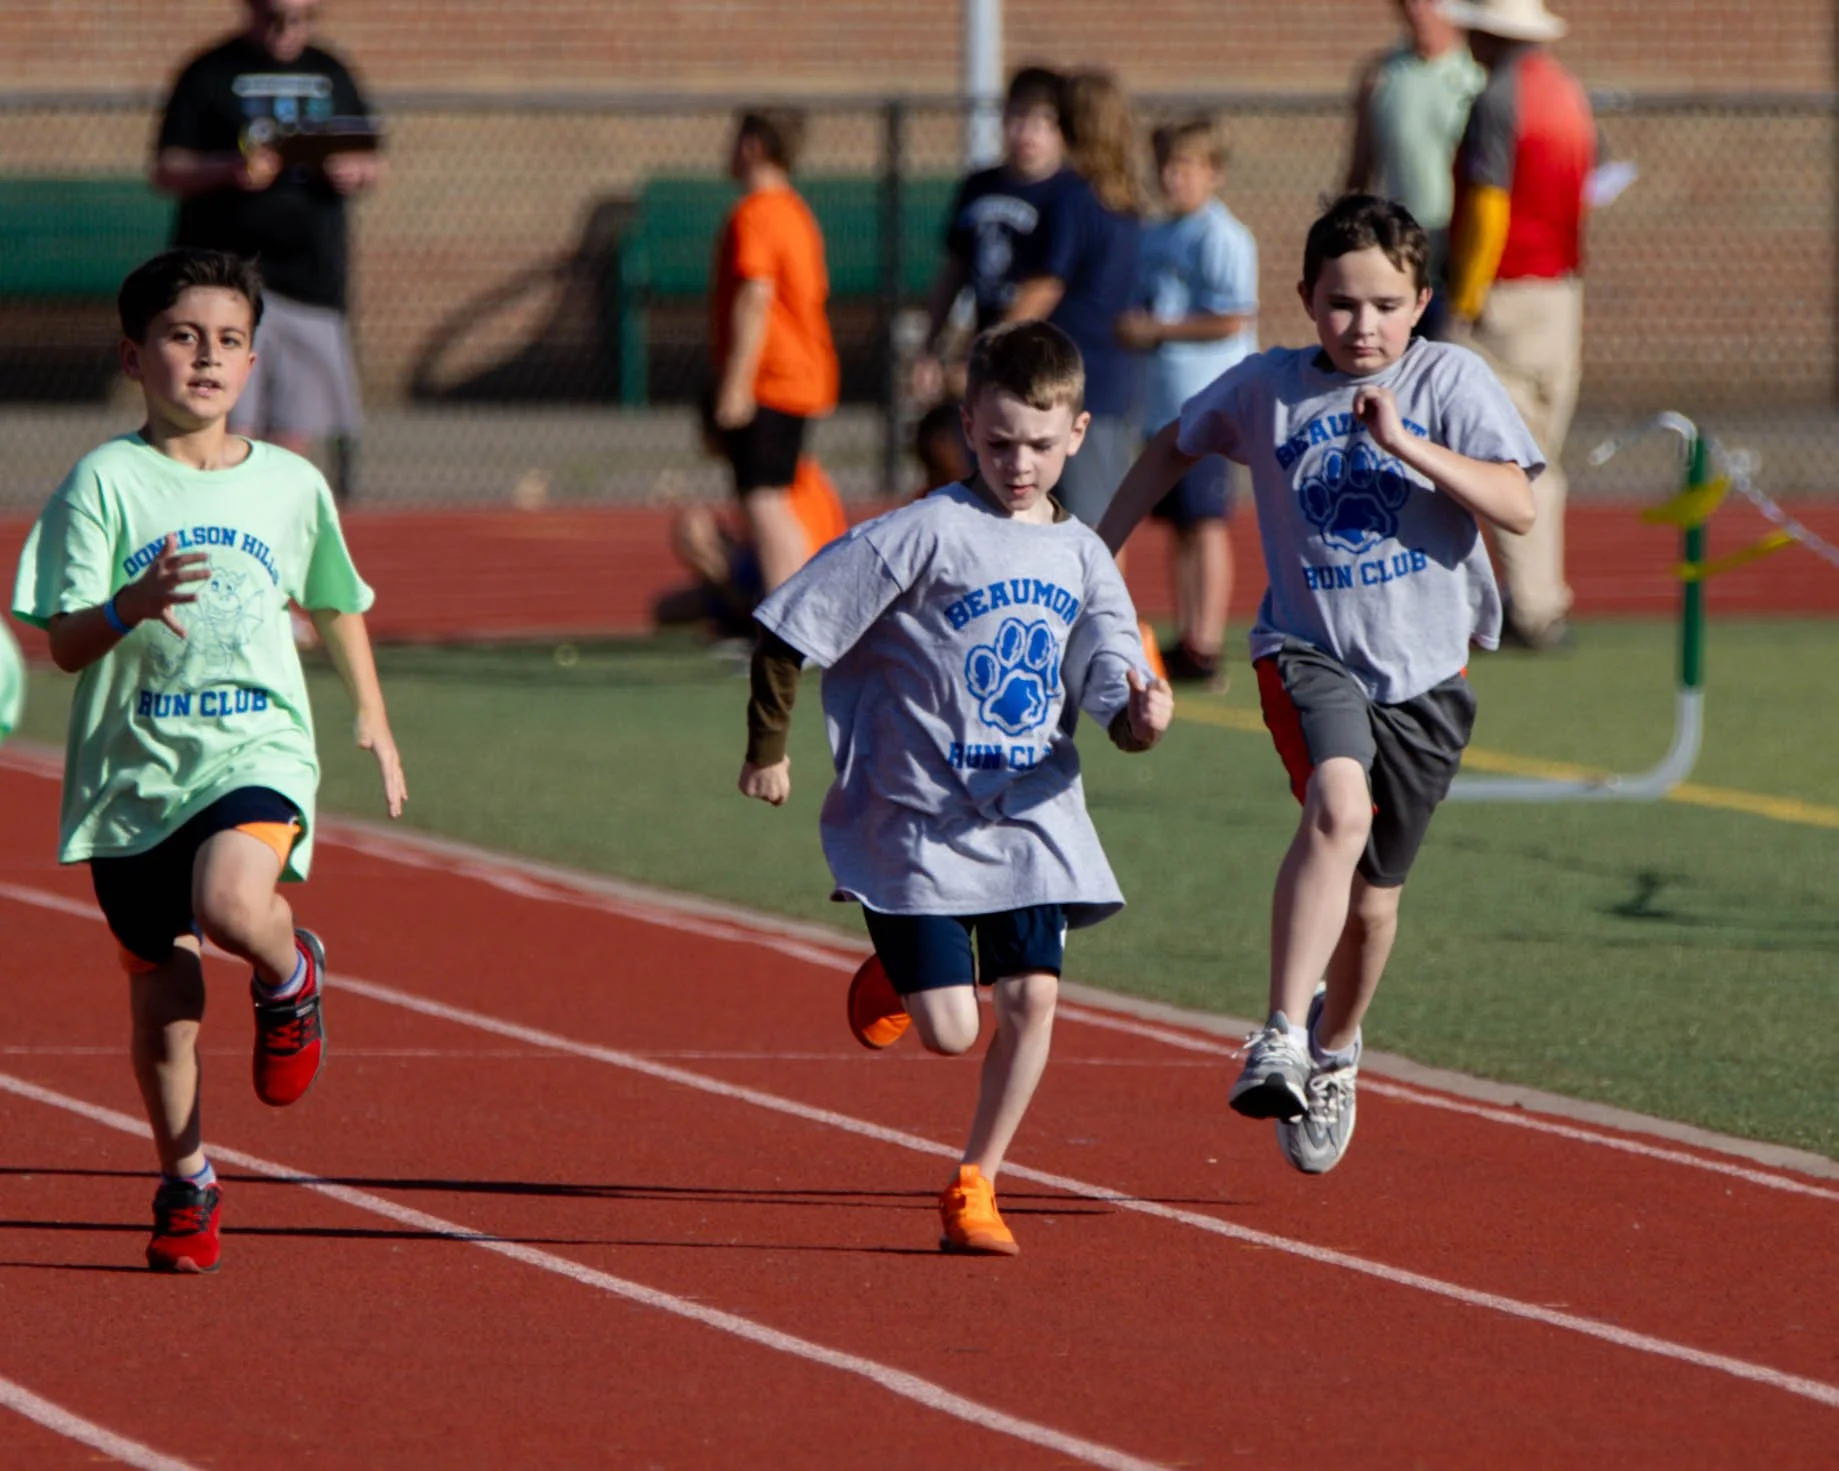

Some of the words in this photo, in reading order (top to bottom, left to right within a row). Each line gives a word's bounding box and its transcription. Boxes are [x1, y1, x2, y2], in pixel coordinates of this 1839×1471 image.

[123, 526, 236, 578] DONLSON
[1303, 564, 1353, 590] RUN
[1361, 547, 1427, 586] CLUB
[944, 578, 1080, 630] BEAUMON
[137, 690, 191, 718] RUN
[200, 688, 268, 717] CLUB
[947, 742, 1002, 769] RUN
[1009, 746, 1051, 770] CL
